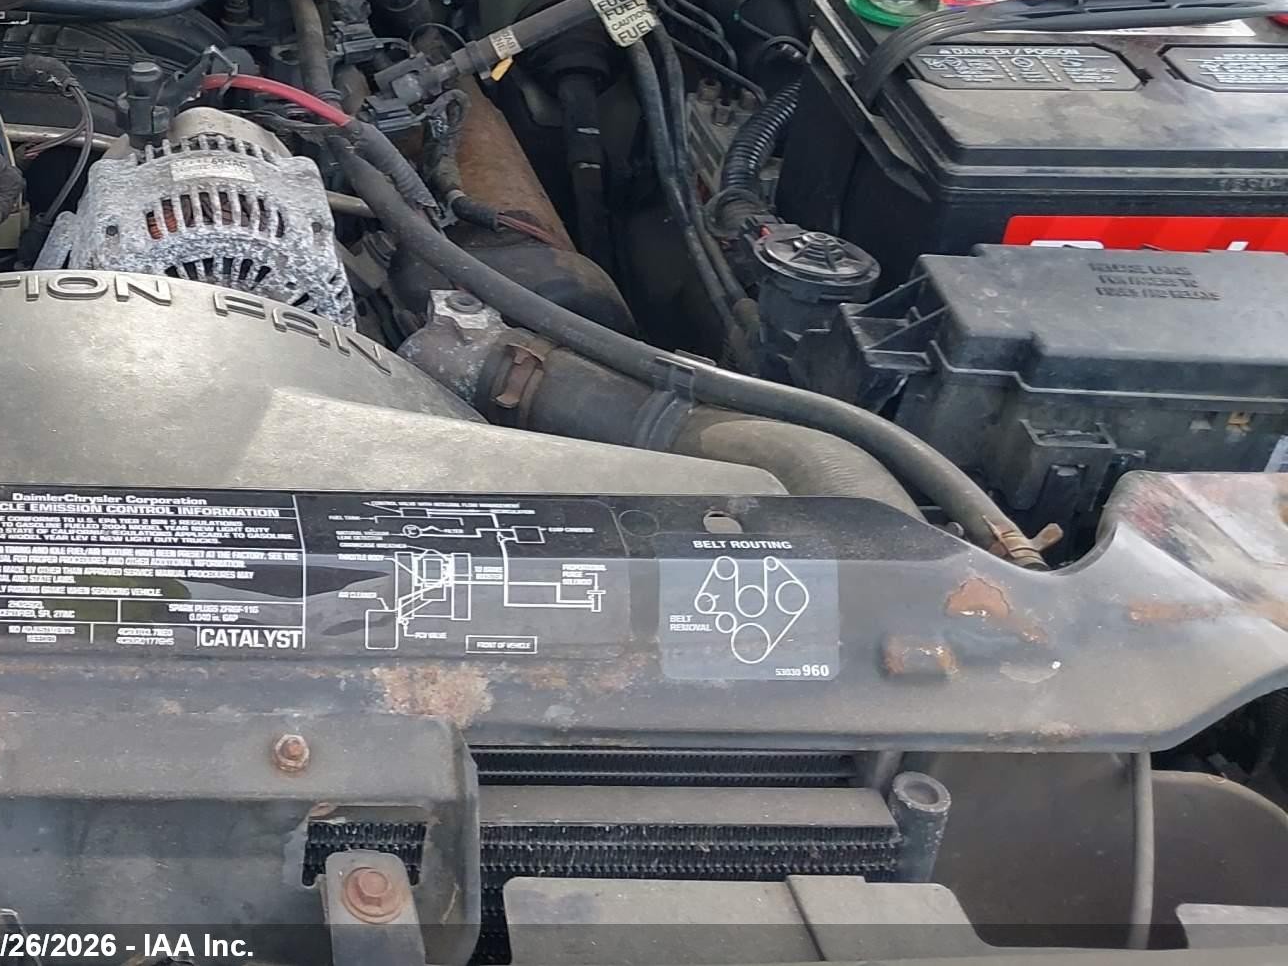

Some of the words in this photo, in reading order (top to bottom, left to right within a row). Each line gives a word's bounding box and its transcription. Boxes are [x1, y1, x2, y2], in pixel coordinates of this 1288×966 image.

[617, 19, 652, 43] FUEL
[213, 290, 394, 376] FAN
[12, 492, 122, 505] DaimlerChrysler
[125, 495, 208, 506] Corporation
[28, 503, 103, 513] EMISSION
[106, 504, 175, 516] CONTROL
[178, 506, 280, 518] INFORMATION
[179, 519, 243, 527] REGULATIONS
[692, 539, 727, 549] BELT
[729, 540, 793, 550] ROUTING
[669, 614, 694, 623] BELT
[200, 628, 303, 649] CATALYST
[801, 664, 830, 677] 960
